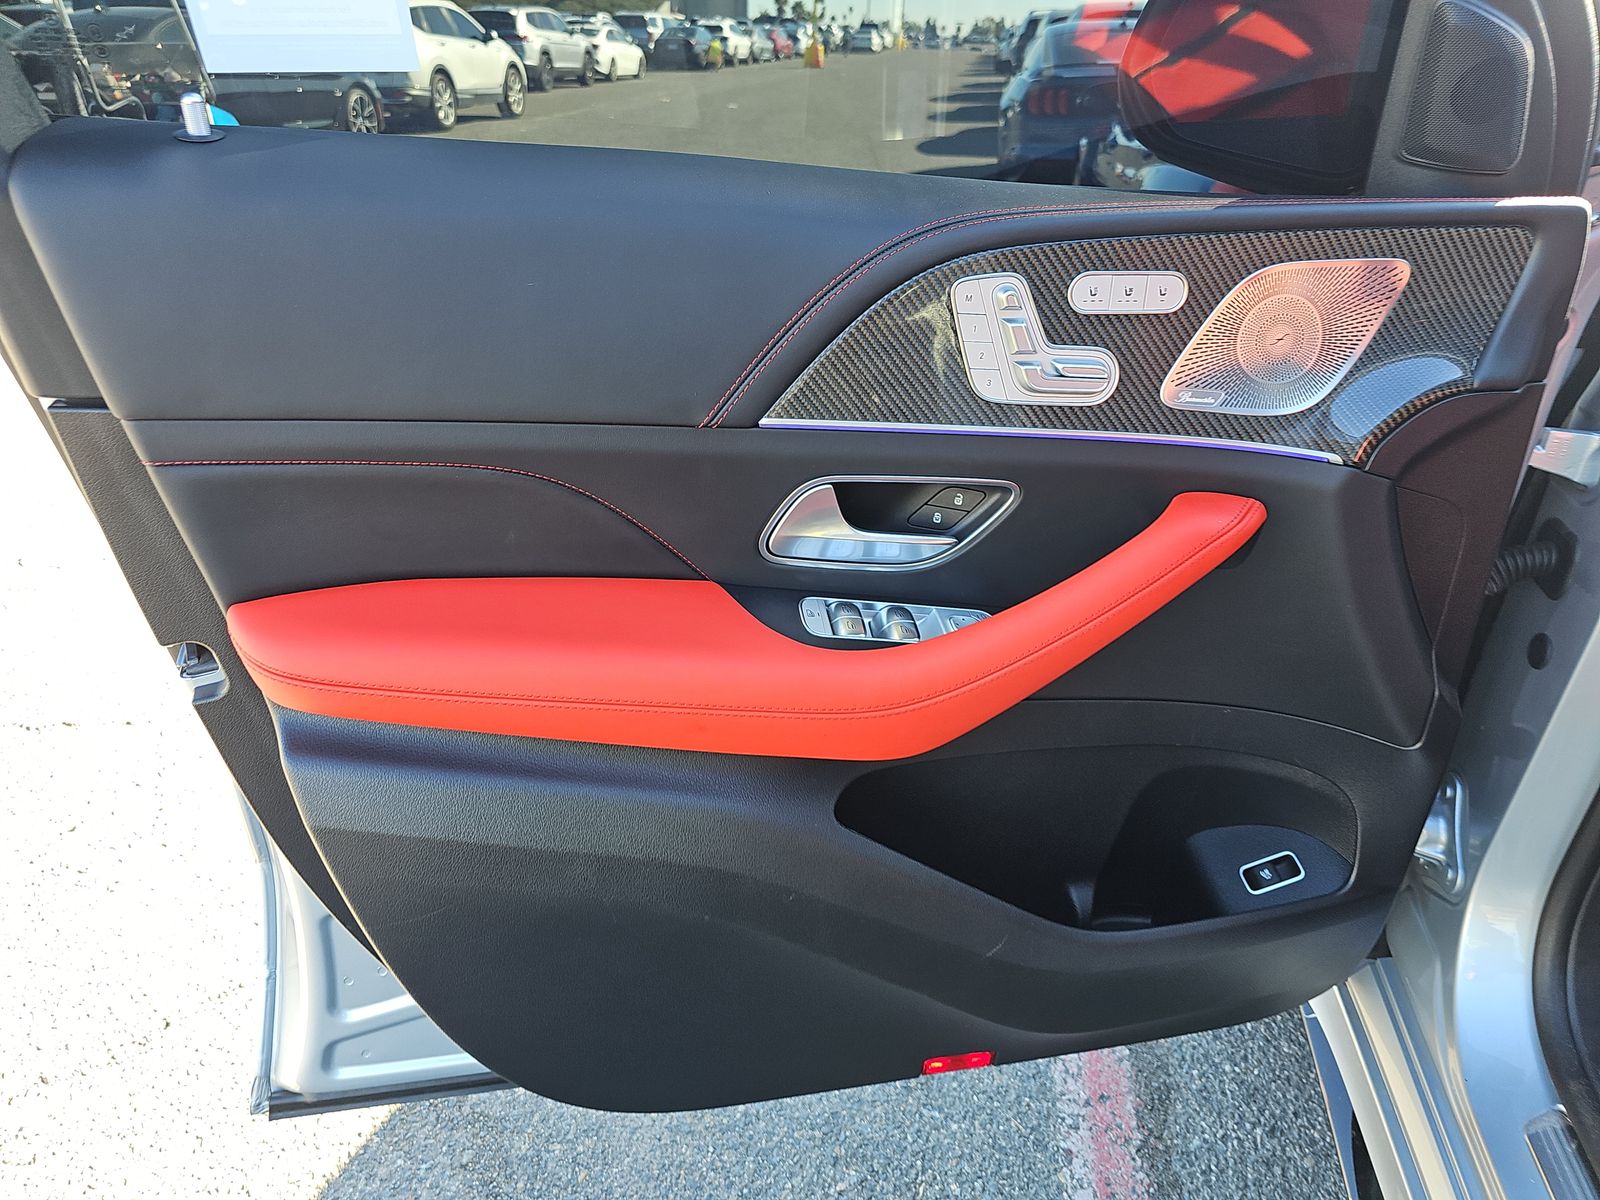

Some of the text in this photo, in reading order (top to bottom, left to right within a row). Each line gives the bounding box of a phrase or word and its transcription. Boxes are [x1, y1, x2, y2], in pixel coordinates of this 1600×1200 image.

[964, 294, 973, 303] M
[972, 325, 977, 333] 1
[979, 352, 985, 360] 2
[986, 379, 992, 387] 3
